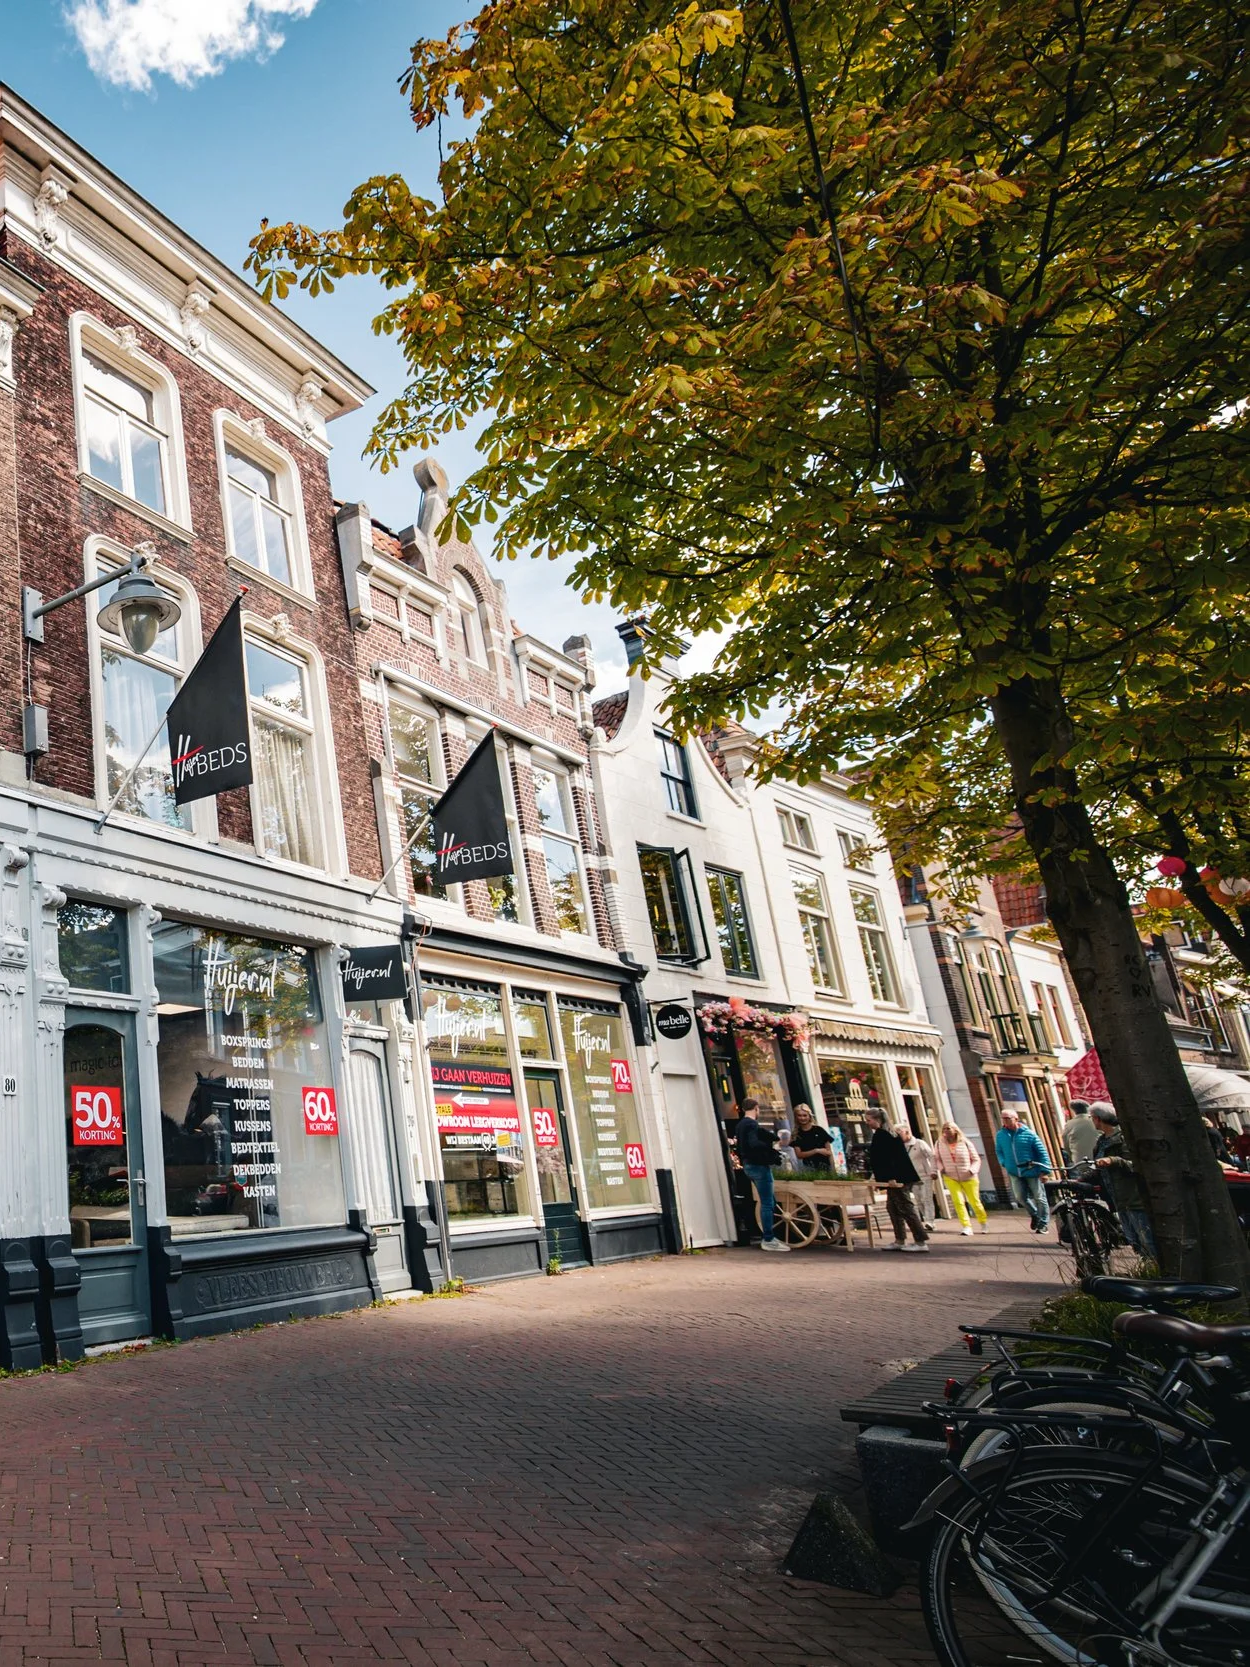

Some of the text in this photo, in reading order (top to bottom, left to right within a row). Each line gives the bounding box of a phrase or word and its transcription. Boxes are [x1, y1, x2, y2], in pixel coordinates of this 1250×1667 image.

[197, 742, 247, 775] BEDS
[461, 842, 508, 865] BEDS
[202, 936, 278, 1016] Huijer.nl
[342, 960, 393, 990] Huijer.nl
[221, 1034, 271, 1049] BOXSPRINGS
[232, 1056, 265, 1069] BEDDEN
[226, 1077, 274, 1090] MATRASSEN
[441, 1068, 466, 1083] GAAN
[466, 1070, 511, 1086] VERHUIZEN
[5, 1078, 16, 1092] 80
[75, 1091, 121, 1128] 50%
[234, 1099, 270, 1111] TOPPERS
[305, 1091, 336, 1122] 60%
[234, 1121, 272, 1132] KUSSENS
[309, 1122, 334, 1132] KORTING
[79, 1130, 116, 1140] KORTING
[231, 1141, 280, 1154] BEDTEXTIEL
[233, 1163, 282, 1176] DEKBEDDEN
[243, 1185, 276, 1198] KASTEN
